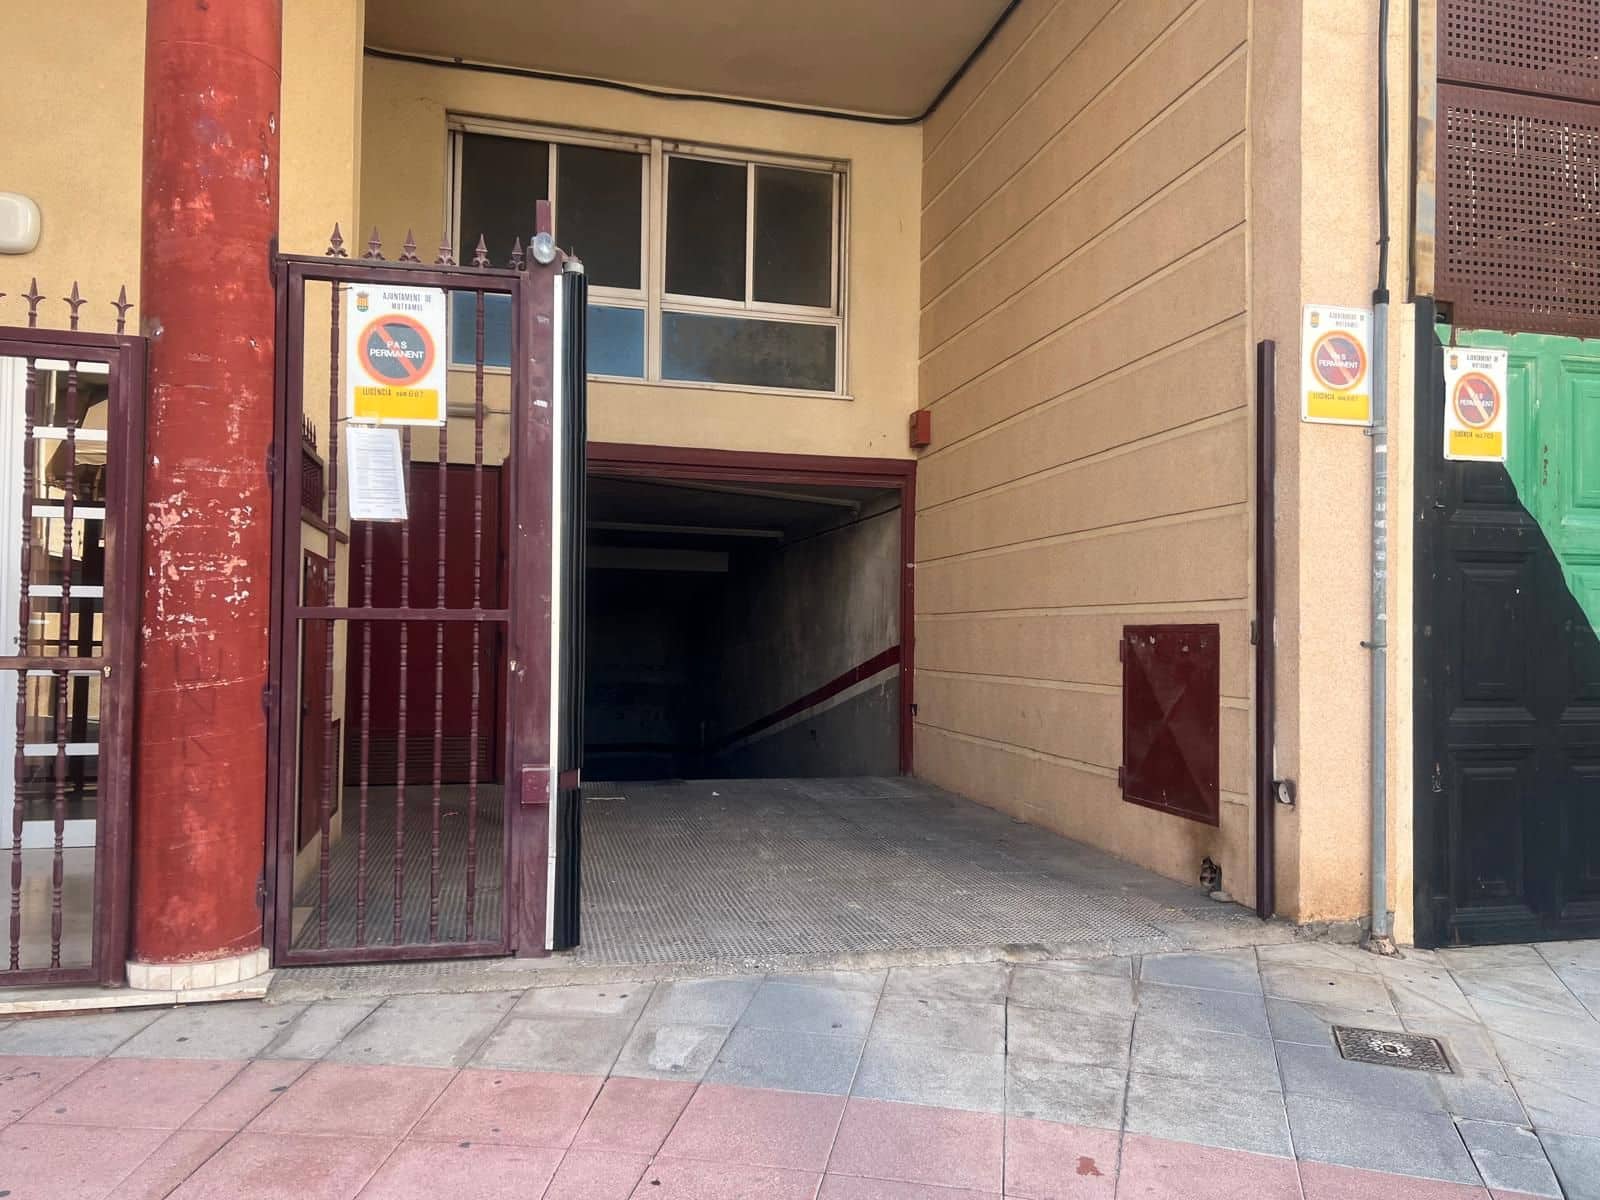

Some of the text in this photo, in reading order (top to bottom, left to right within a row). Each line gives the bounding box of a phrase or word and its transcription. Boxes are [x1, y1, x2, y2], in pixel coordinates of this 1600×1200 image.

[387, 340, 407, 349] PAS
[369, 348, 424, 359] PERMANENT
[1460, 399, 1494, 408] PERMENT
